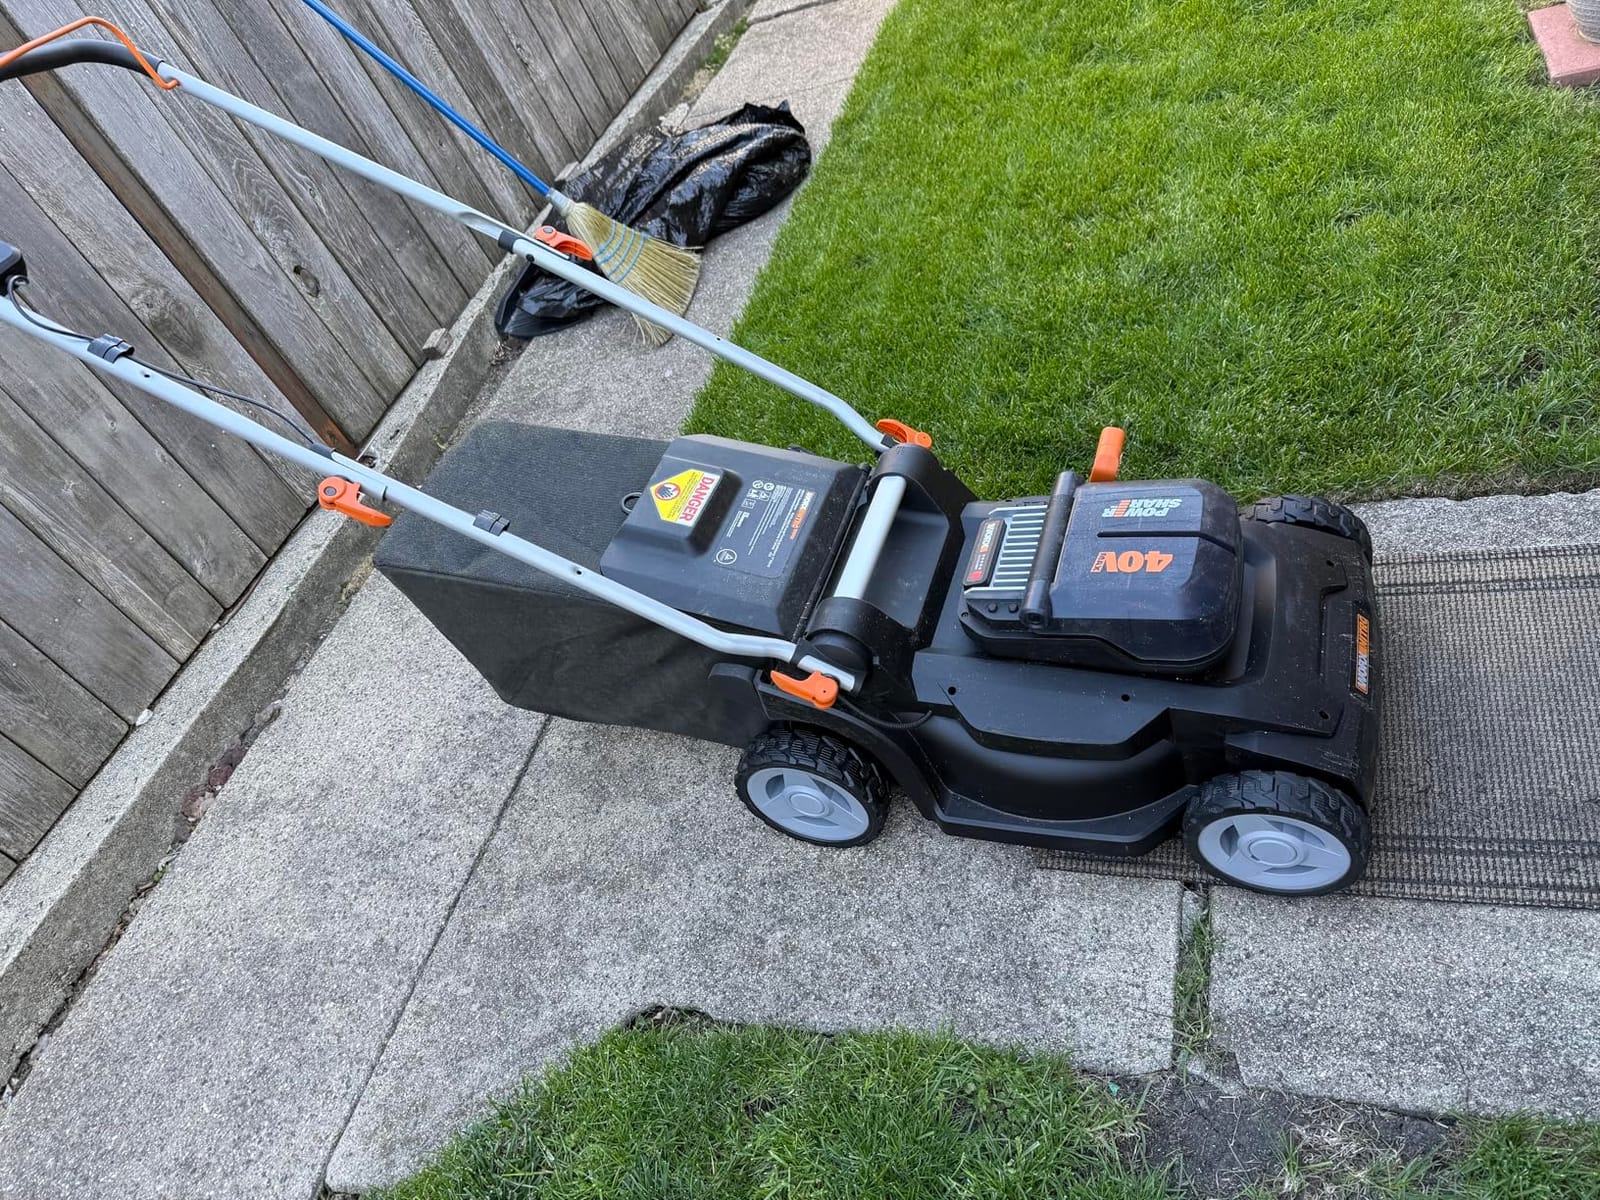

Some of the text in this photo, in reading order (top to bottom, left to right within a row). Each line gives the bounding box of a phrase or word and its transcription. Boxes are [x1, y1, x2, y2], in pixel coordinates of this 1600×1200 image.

[679, 476, 715, 522] DANGER
[1116, 499, 1183, 509] SHARE
[1102, 508, 1169, 518] POWER
[1090, 550, 1174, 573] 40V
[1357, 615, 1369, 688] WORX NITRO
